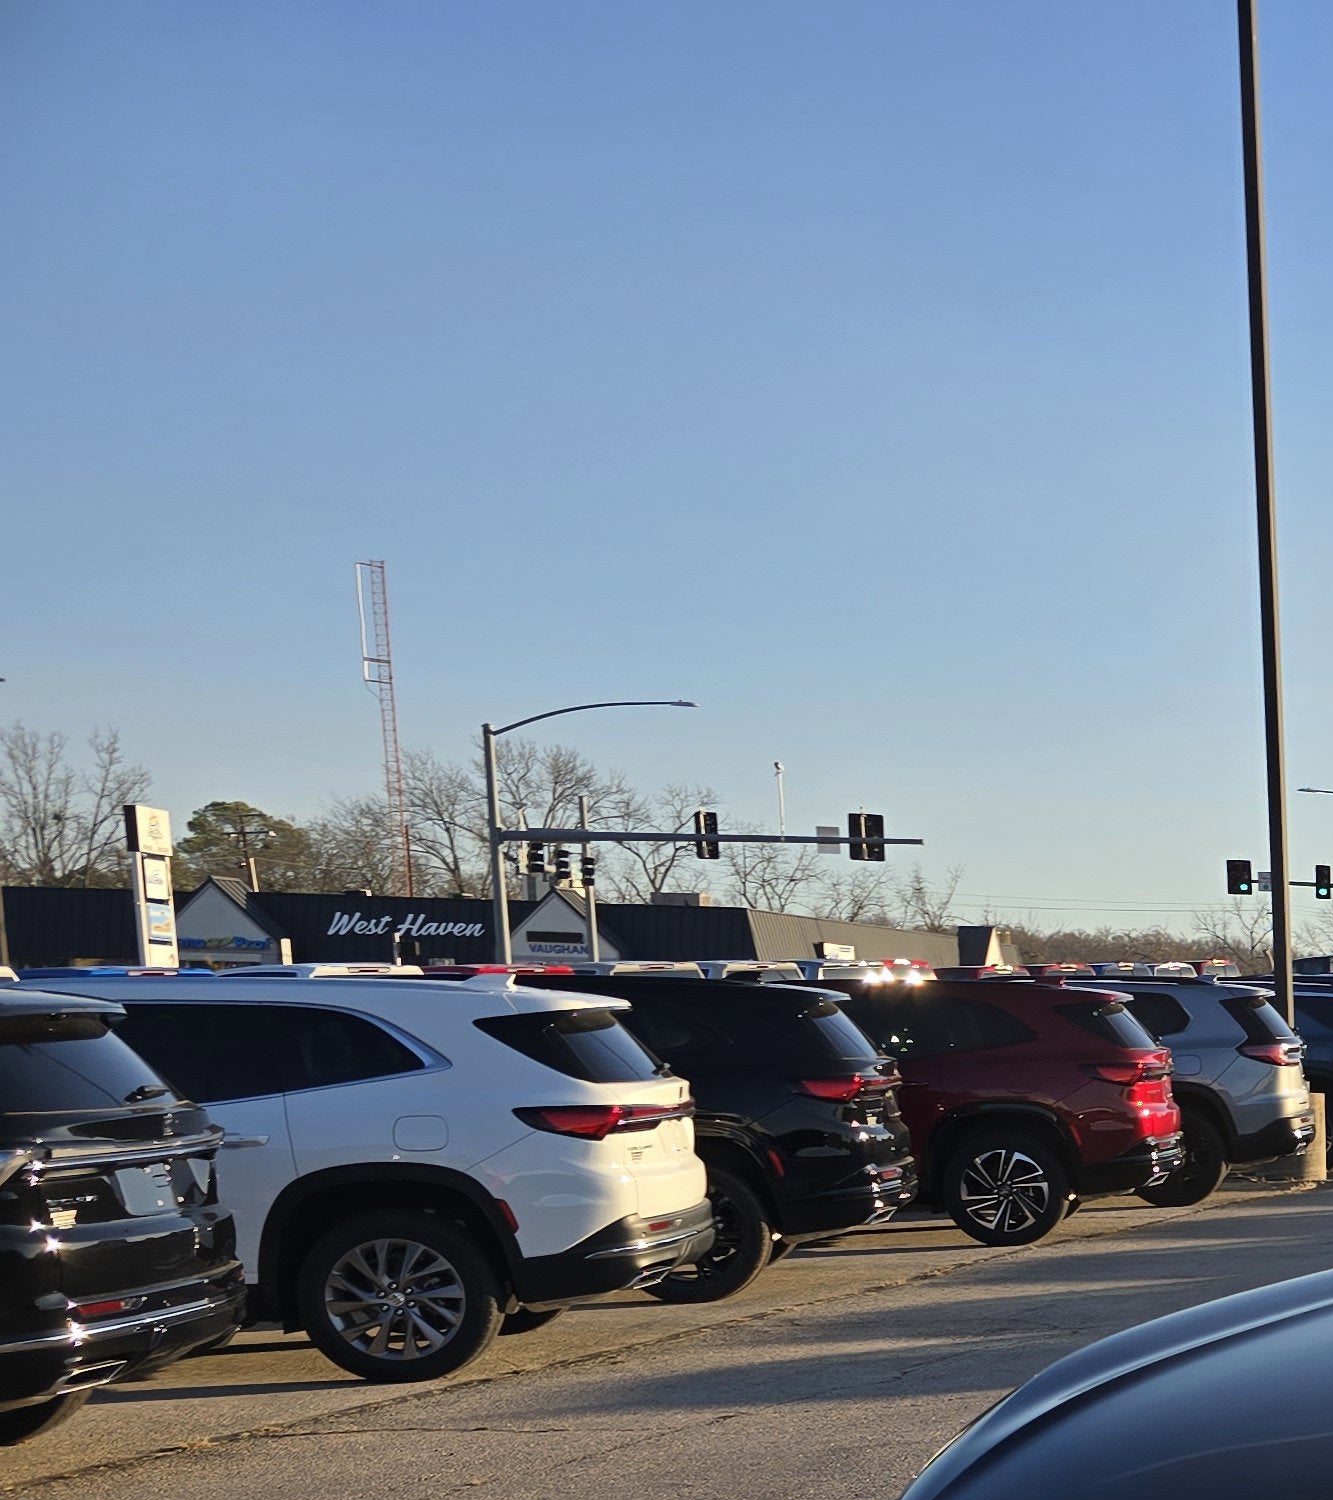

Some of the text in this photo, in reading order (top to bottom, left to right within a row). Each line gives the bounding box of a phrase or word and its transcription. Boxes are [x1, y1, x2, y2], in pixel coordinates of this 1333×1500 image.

[327, 911, 486, 939] West Haven
[529, 944, 590, 955] VAUGHAN
